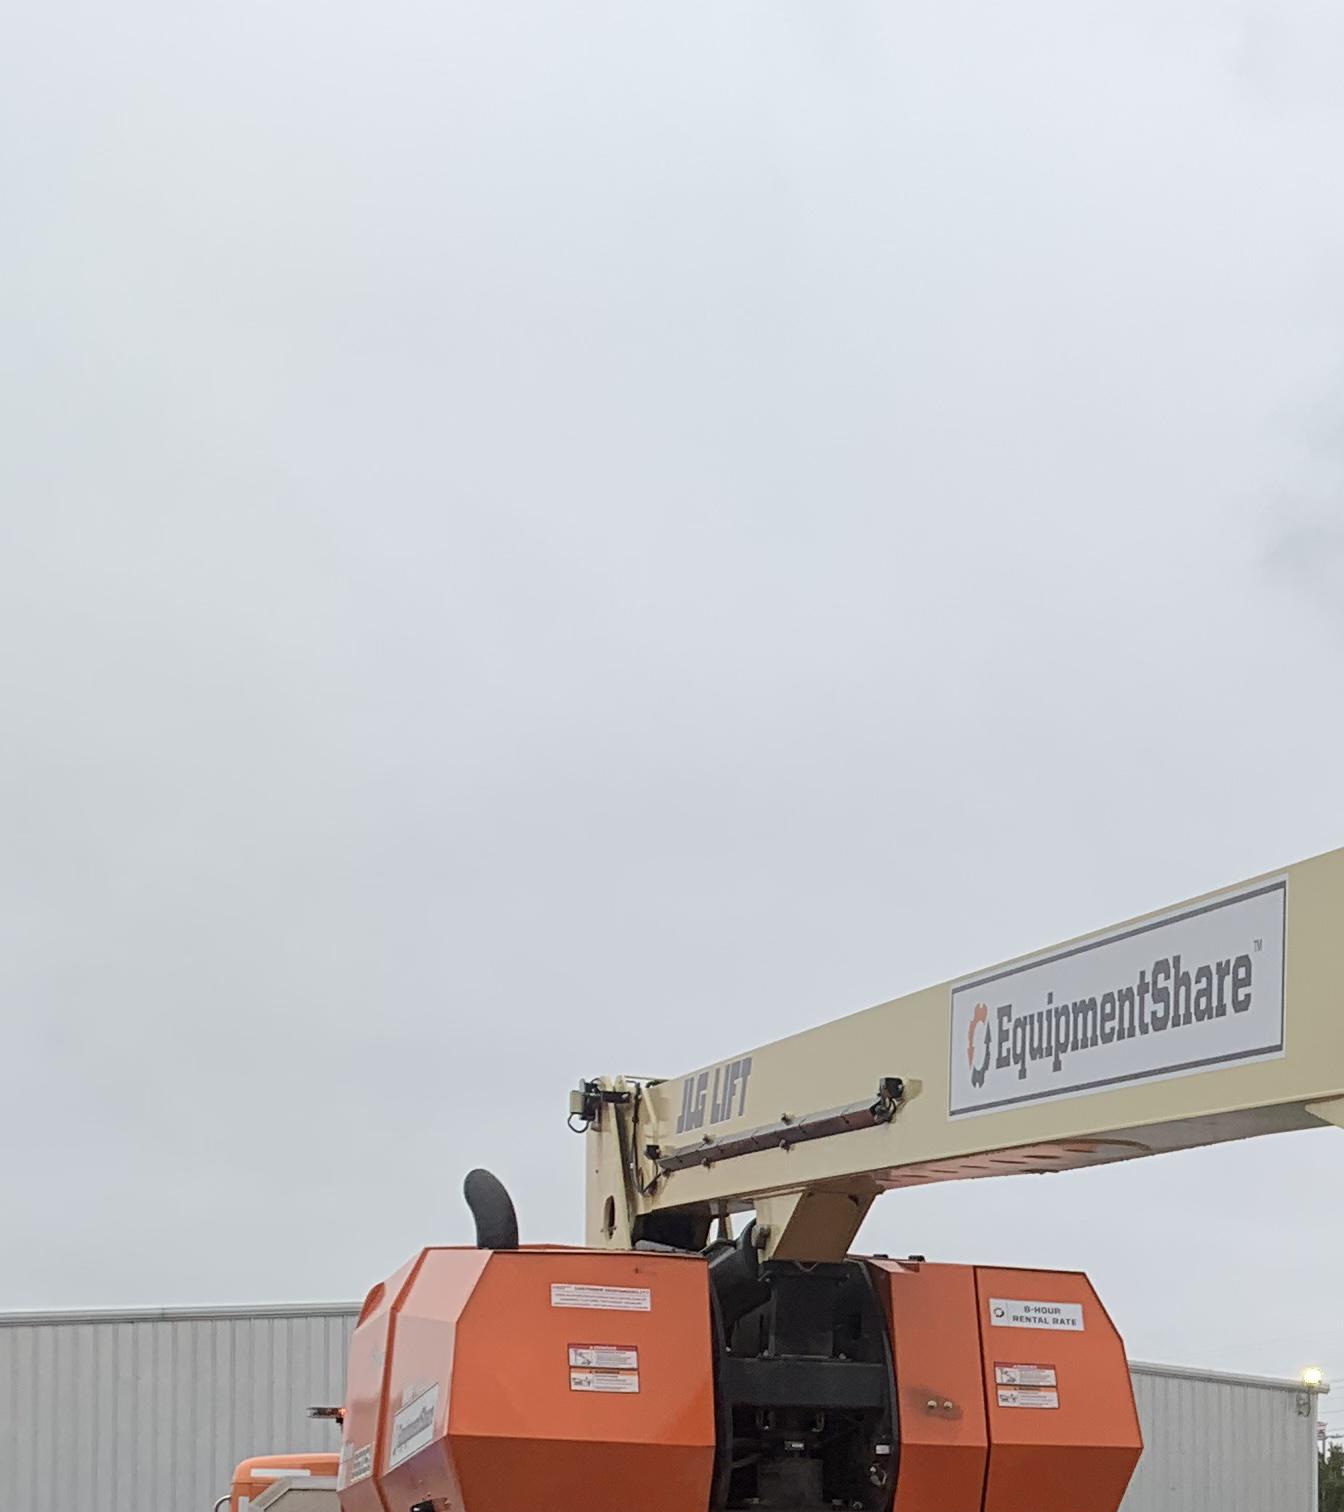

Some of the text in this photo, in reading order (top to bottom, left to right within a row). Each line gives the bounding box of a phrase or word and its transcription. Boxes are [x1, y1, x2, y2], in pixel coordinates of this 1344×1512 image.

[995, 954, 1253, 1080] EquipmentShare
[676, 1057, 752, 1134] JLG LIFT
[1012, 1315, 1077, 1327] RENTAL RATE
[1023, 1305, 1061, 1315] 8-HOUR
